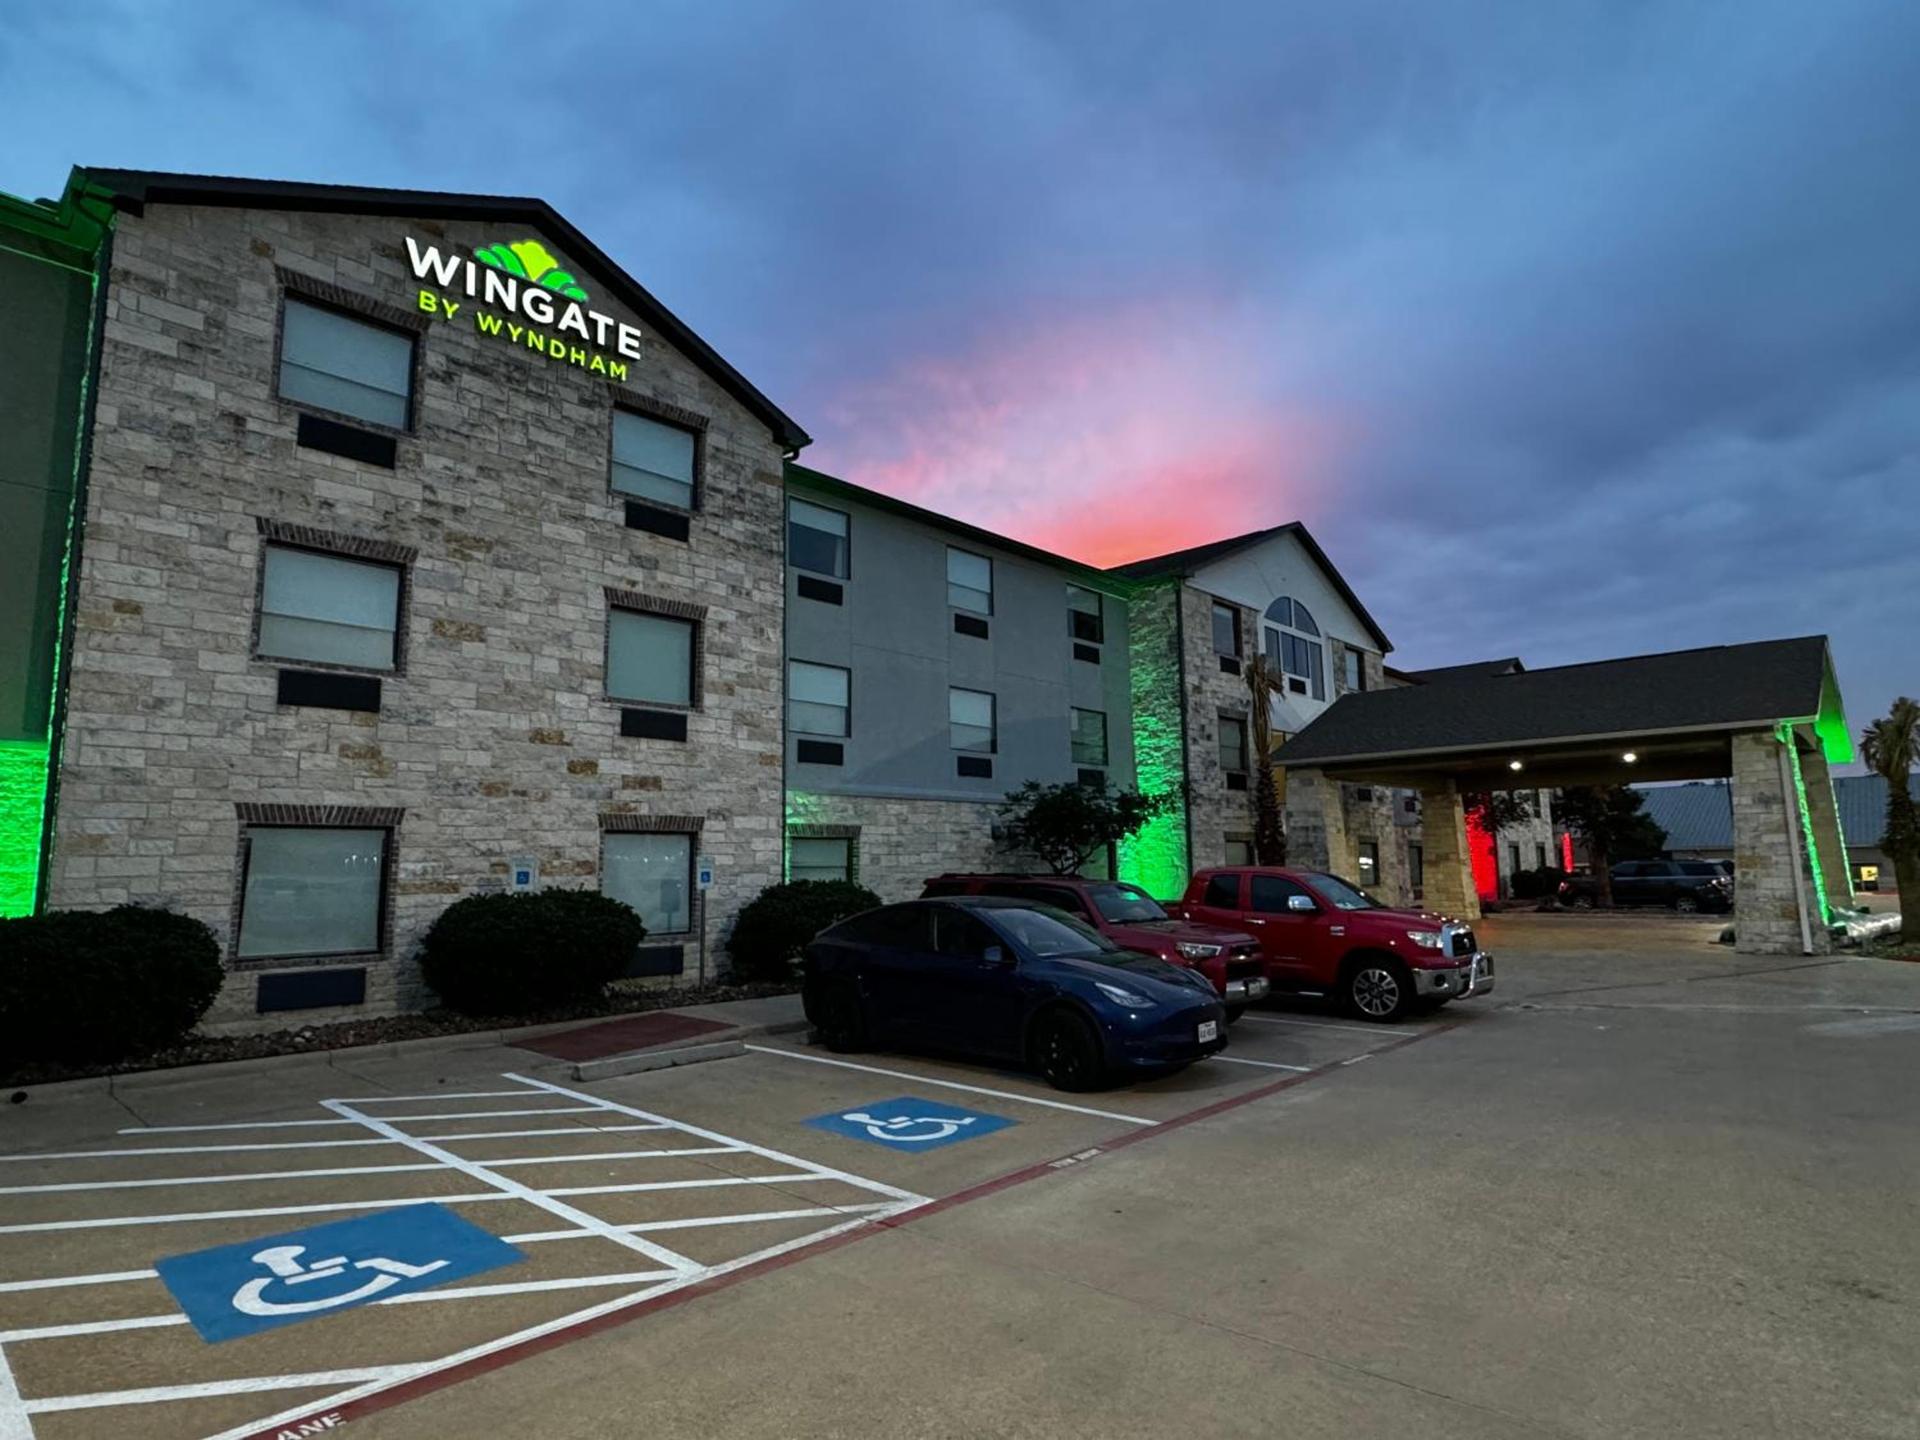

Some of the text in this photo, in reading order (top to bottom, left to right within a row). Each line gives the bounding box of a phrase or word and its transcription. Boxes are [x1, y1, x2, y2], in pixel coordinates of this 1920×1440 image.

[405, 236, 642, 360] WINGATE
[418, 289, 629, 382] BY WYNDHAM
